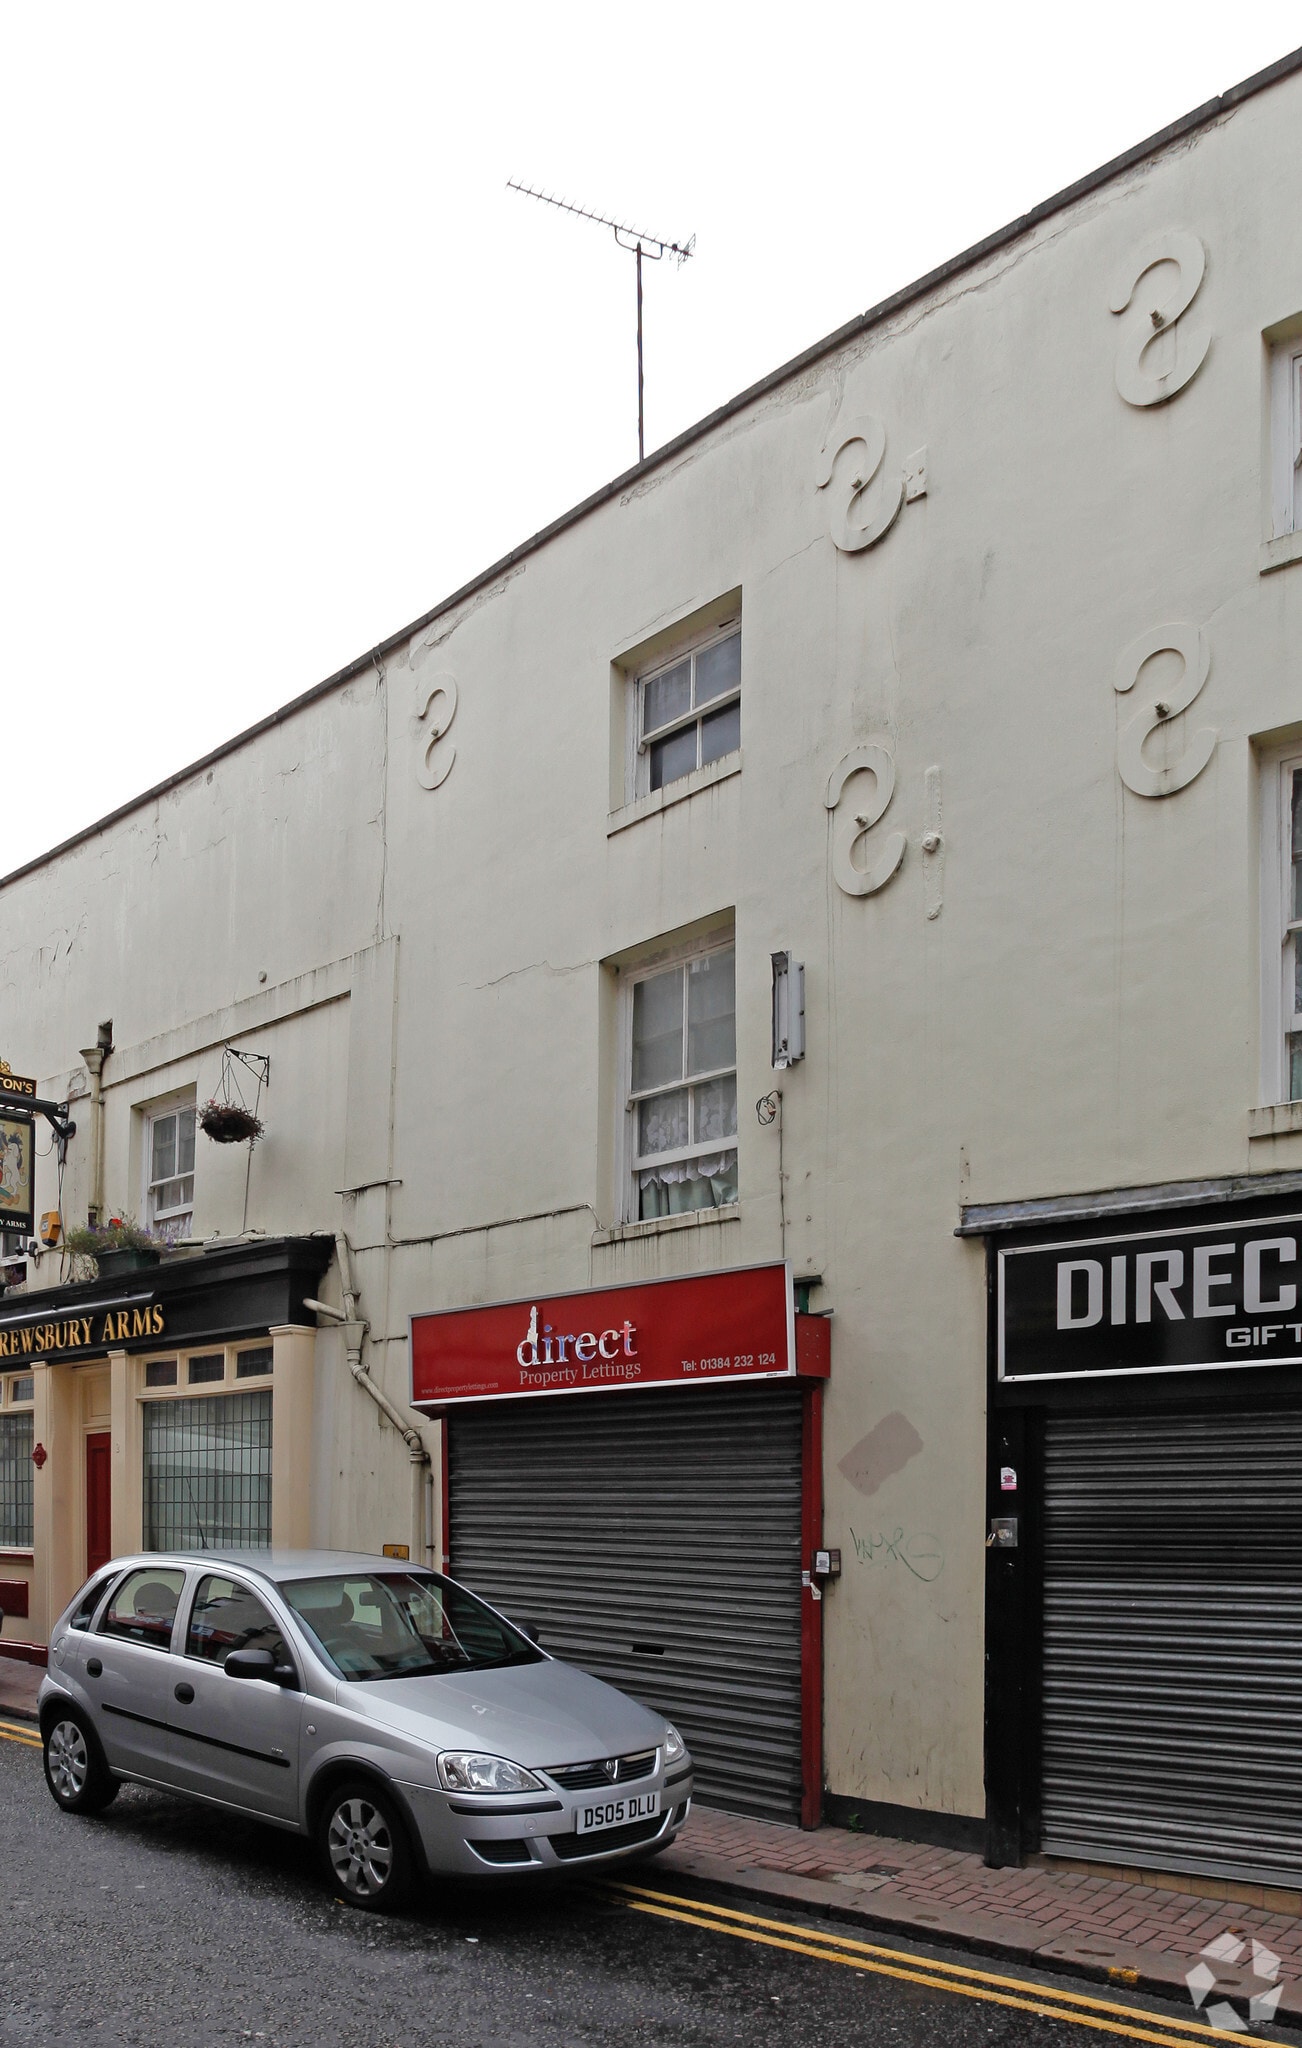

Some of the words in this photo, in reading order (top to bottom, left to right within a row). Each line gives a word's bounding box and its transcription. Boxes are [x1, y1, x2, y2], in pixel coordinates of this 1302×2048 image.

[6, 1220, 27, 1229] ARMS
[1057, 1237, 1297, 1330] DIREC
[0, 1316, 93, 1356] REWSBURY
[101, 1304, 165, 1342] ARMS
[516, 1305, 638, 1367] direct
[519, 1369, 578, 1387] Property
[582, 1361, 642, 1380] Lettings
[681, 1360, 697, 1371] Tel:
[700, 1357, 730, 1370] 01384
[734, 1354, 753, 1367] 232
[757, 1352, 776, 1365] 124
[421, 1381, 499, 1395] www.directpropertylettings.com
[584, 1801, 624, 1828] DS05
[628, 1794, 656, 1818] DLU
